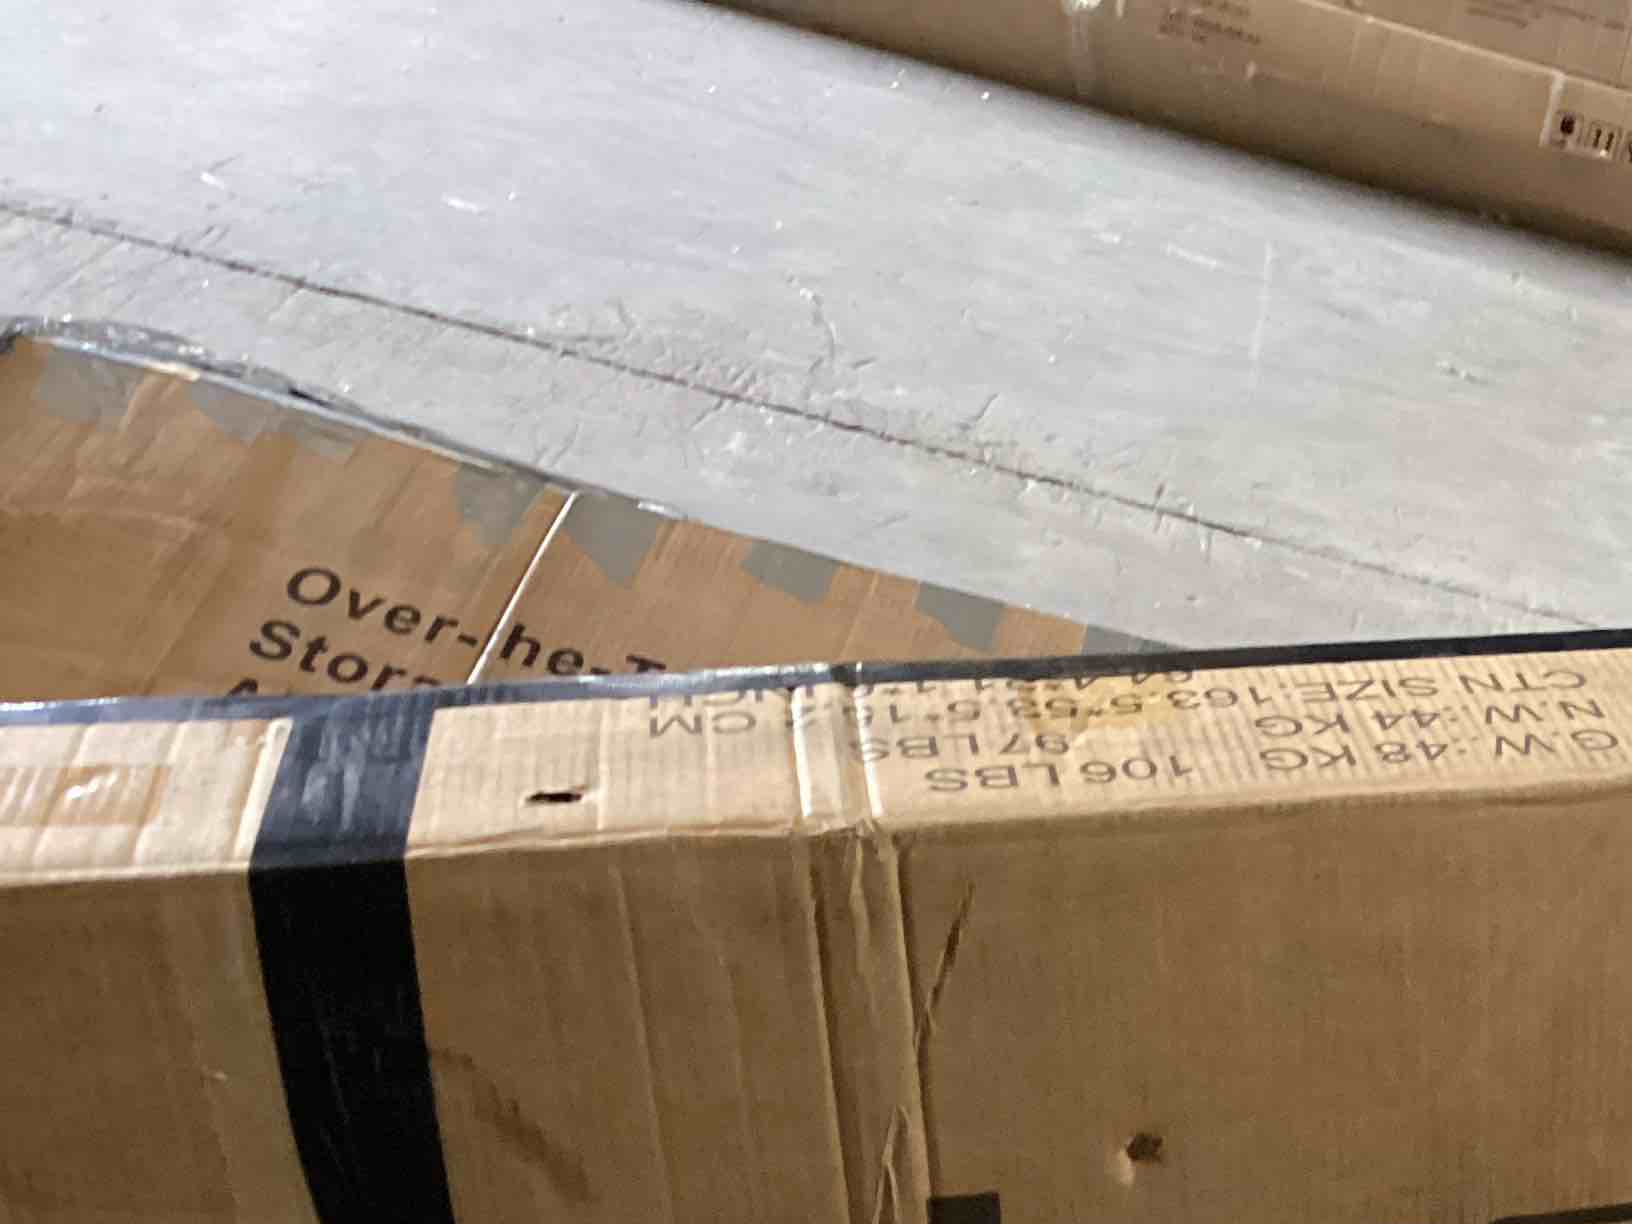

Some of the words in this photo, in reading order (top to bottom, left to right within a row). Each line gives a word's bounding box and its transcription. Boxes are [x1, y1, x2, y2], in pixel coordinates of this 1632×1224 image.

[1459, 670, 1586, 694] CTN
[1255, 712, 1351, 738] KG
[1080, 755, 1192, 785] 106
[1259, 744, 1356, 771] KG
[925, 760, 1061, 793] LBS
